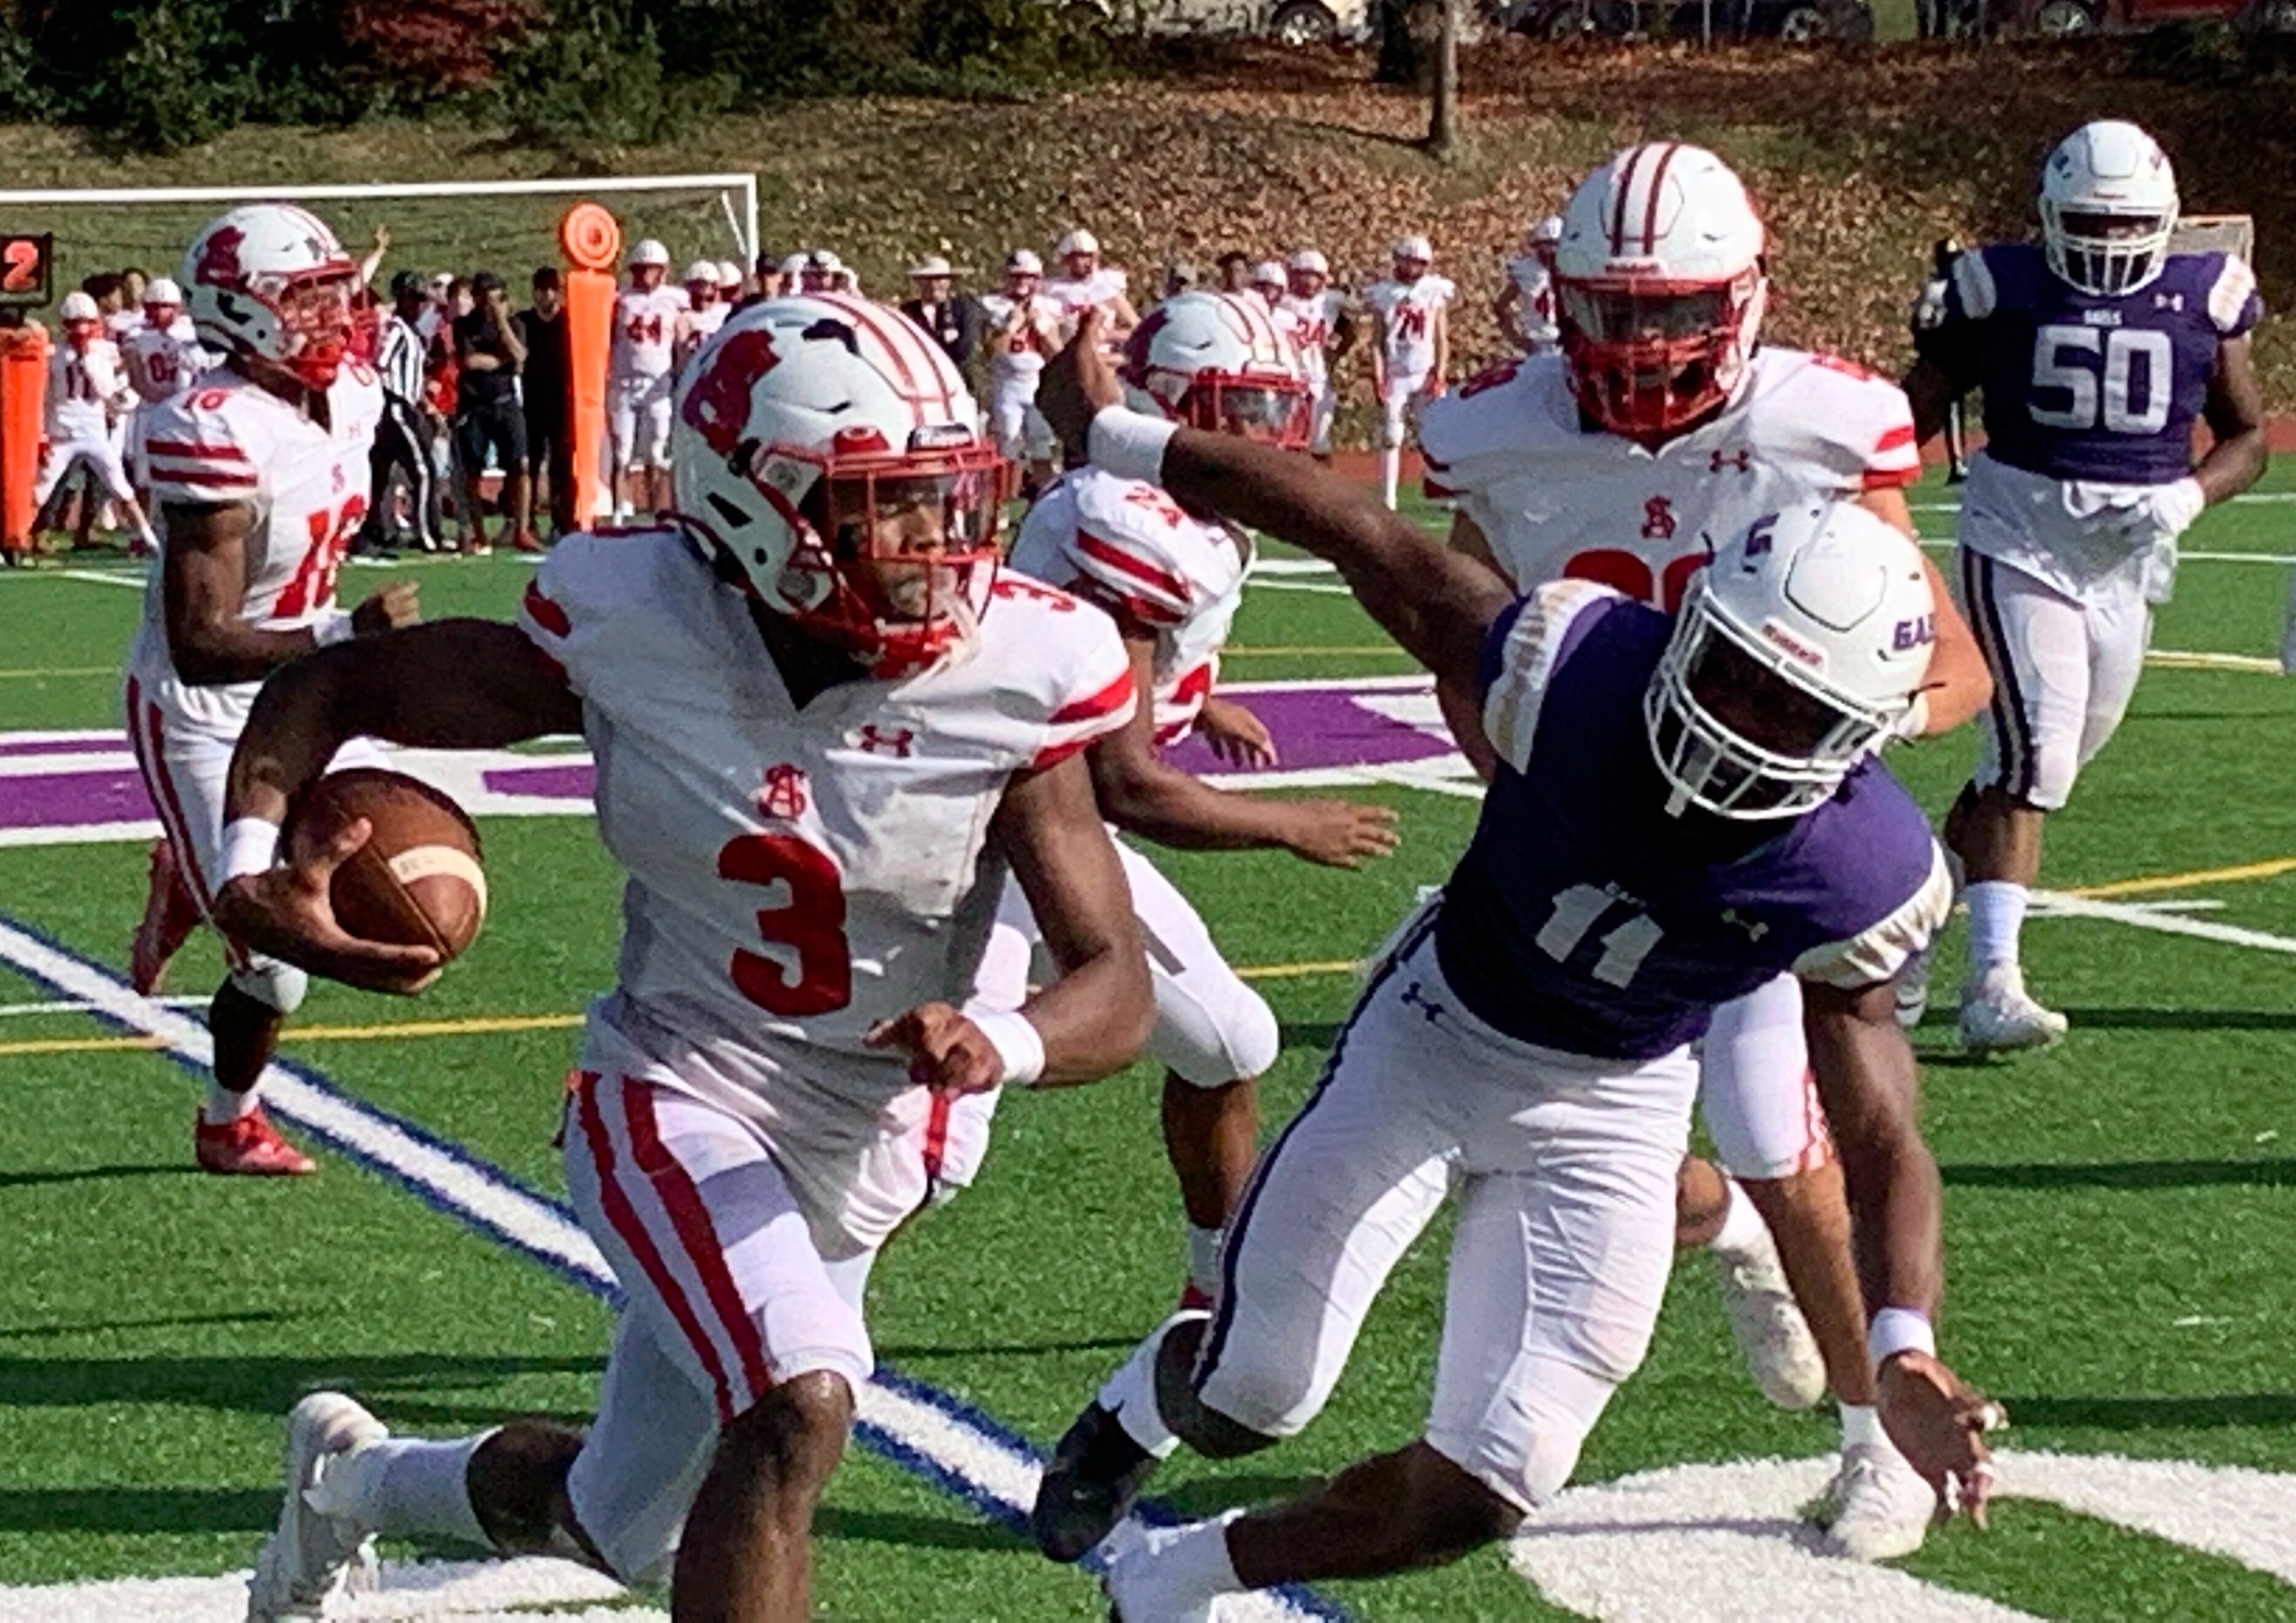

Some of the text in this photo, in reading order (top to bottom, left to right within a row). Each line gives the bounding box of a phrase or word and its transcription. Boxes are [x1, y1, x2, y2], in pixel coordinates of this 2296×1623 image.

[3, 239, 39, 292] 2
[626, 315, 662, 346] 44
[2027, 324, 2173, 434] 50
[718, 834, 851, 1016] 3
[1535, 883, 1665, 990] 11
